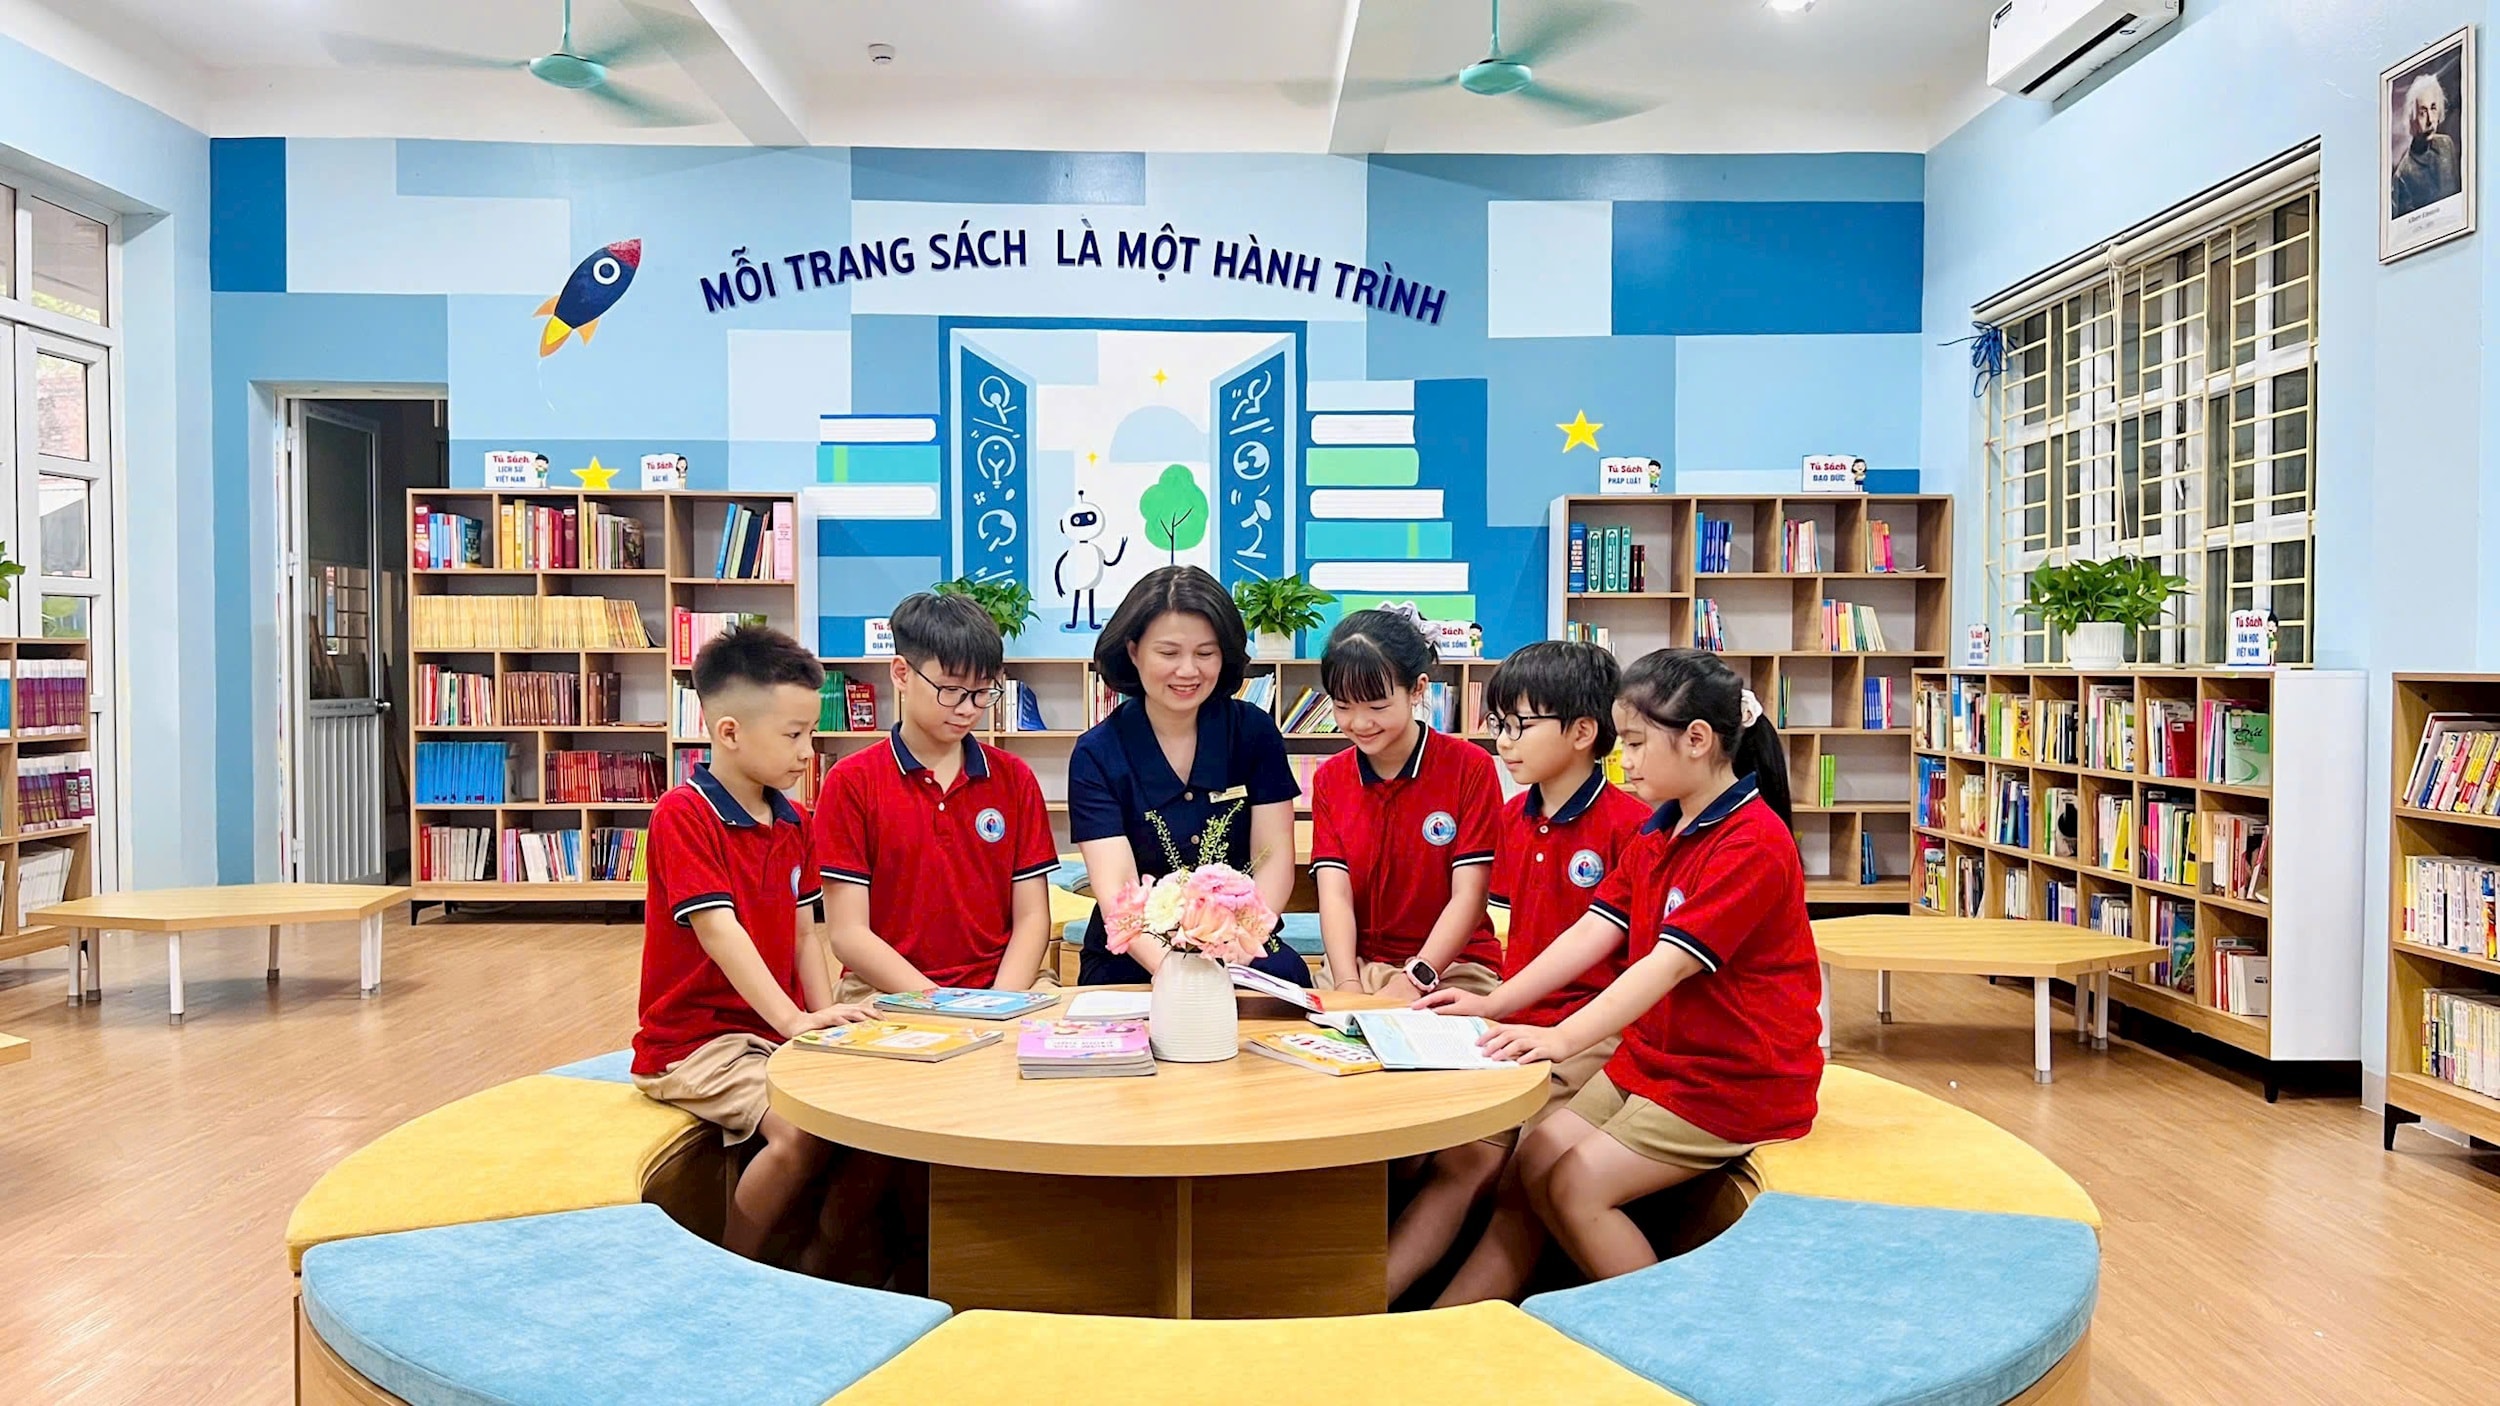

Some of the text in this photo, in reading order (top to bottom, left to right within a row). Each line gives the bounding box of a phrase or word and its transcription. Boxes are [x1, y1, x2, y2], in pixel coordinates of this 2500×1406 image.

[700, 217, 1447, 324] MỖI TRANG SÁCH LÀ MỘT HÀNH TRÌNH
[507, 454, 530, 463] Sách
[1608, 464, 1642, 473] Tủ Sách
[1810, 461, 1846, 470] Tủ Sách
[2236, 616, 2263, 628] Tủ Sách
[1442, 626, 1464, 635] Sách
